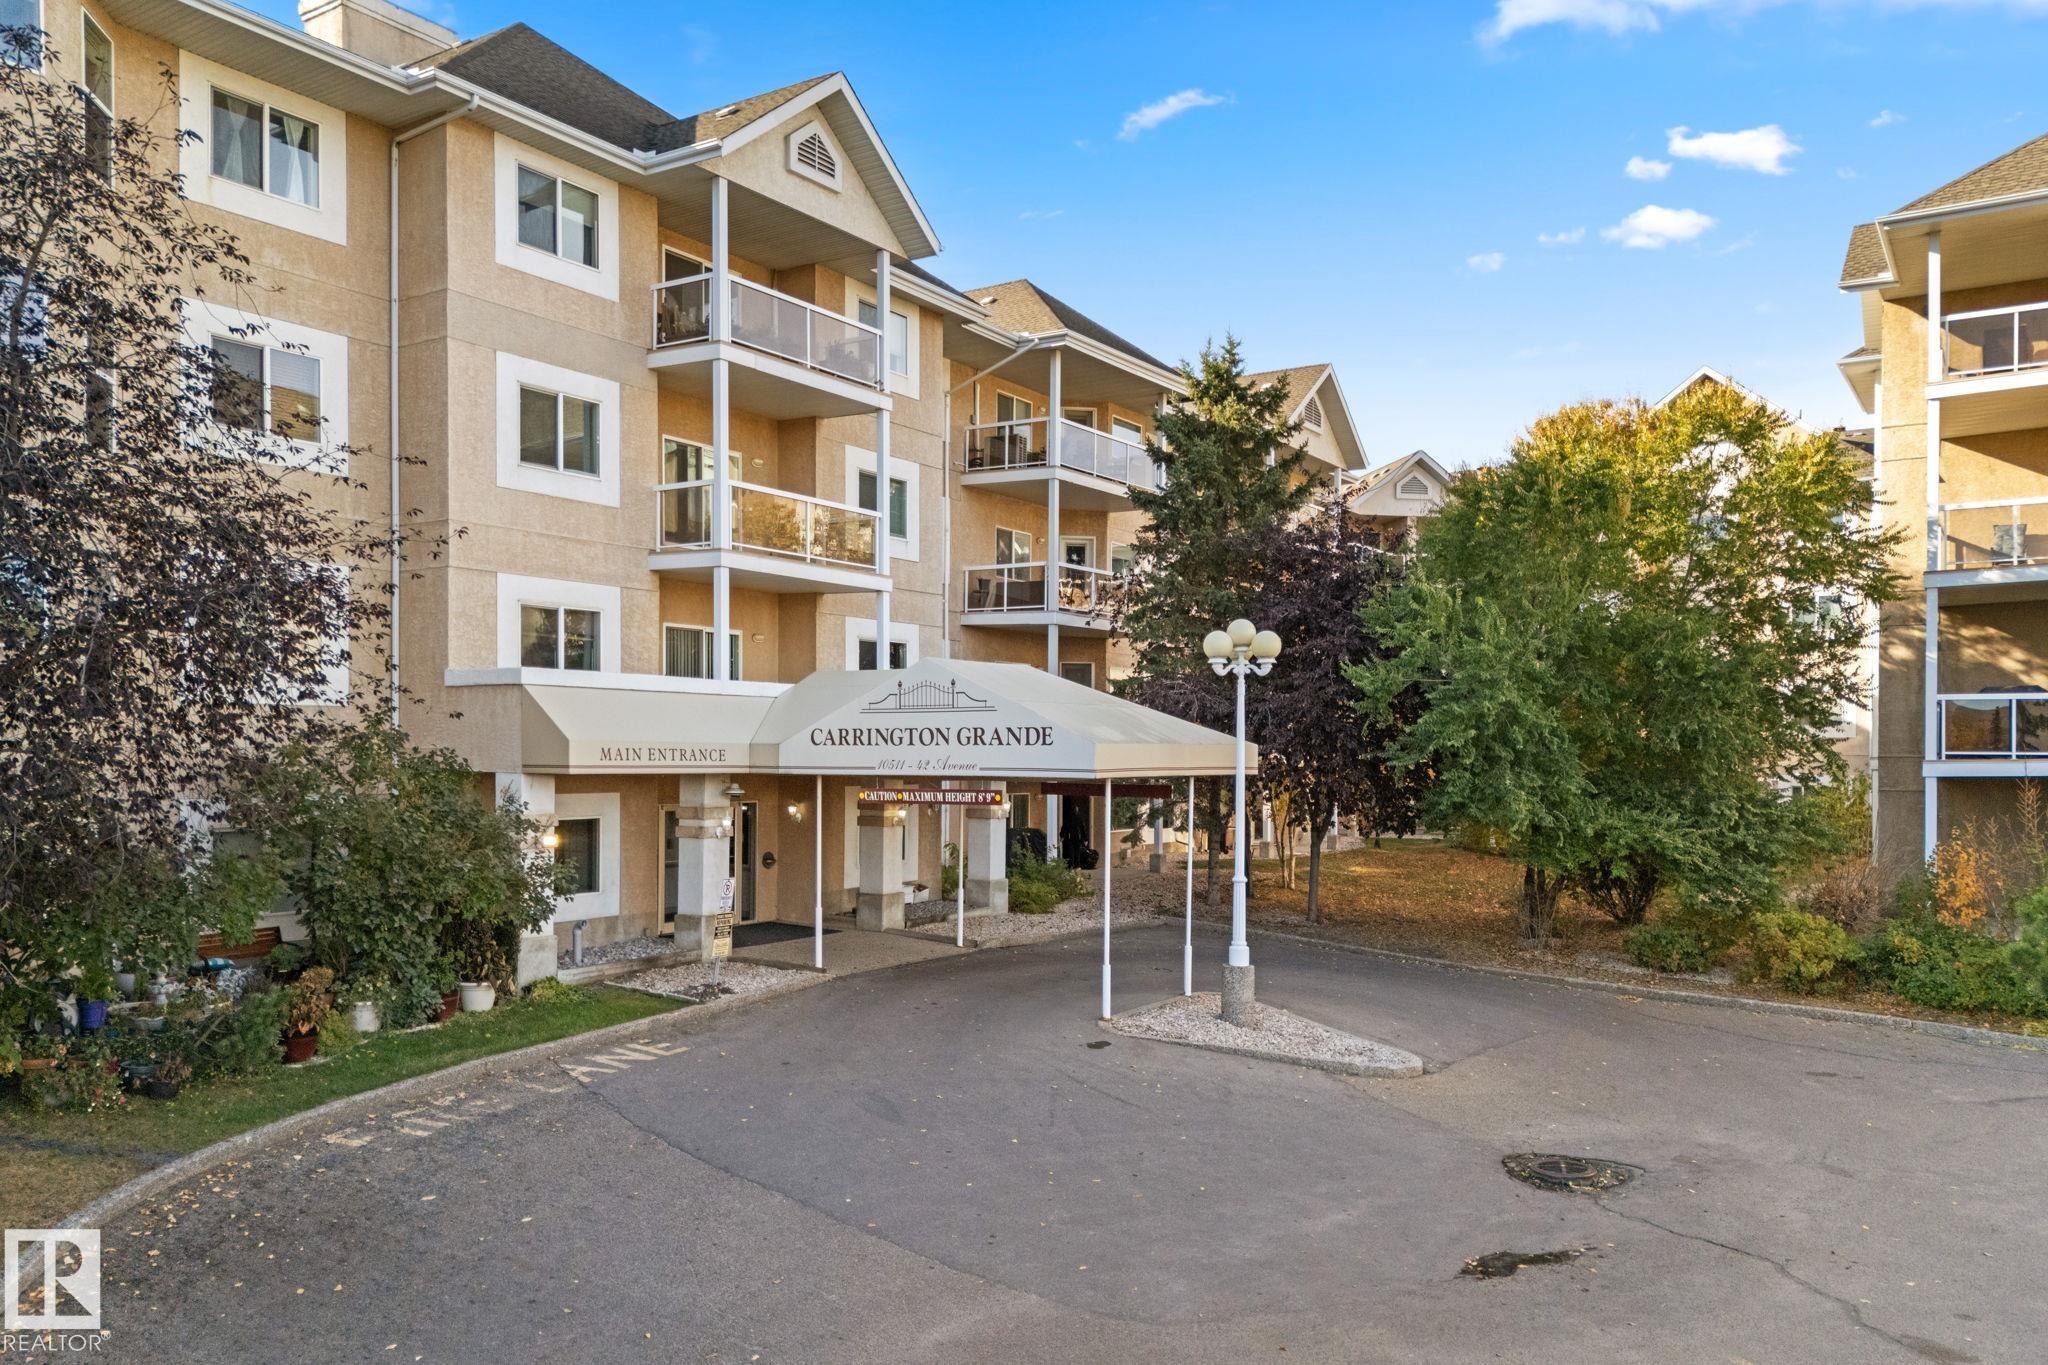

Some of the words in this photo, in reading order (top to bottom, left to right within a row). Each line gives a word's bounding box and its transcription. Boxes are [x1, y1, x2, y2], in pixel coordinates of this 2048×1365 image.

[810, 727, 951, 747] CARRINGTON
[956, 726, 1054, 747] GRANDE
[600, 747, 642, 761] MAIN
[648, 748, 727, 762] ENTRANCE
[876, 757, 906, 772] 10511
[916, 758, 930, 772] 42
[932, 755, 979, 772] Avenue
[864, 791, 898, 801] CAUTION
[902, 791, 943, 802] MAXIMUM
[945, 792, 976, 803] HEIGHT
